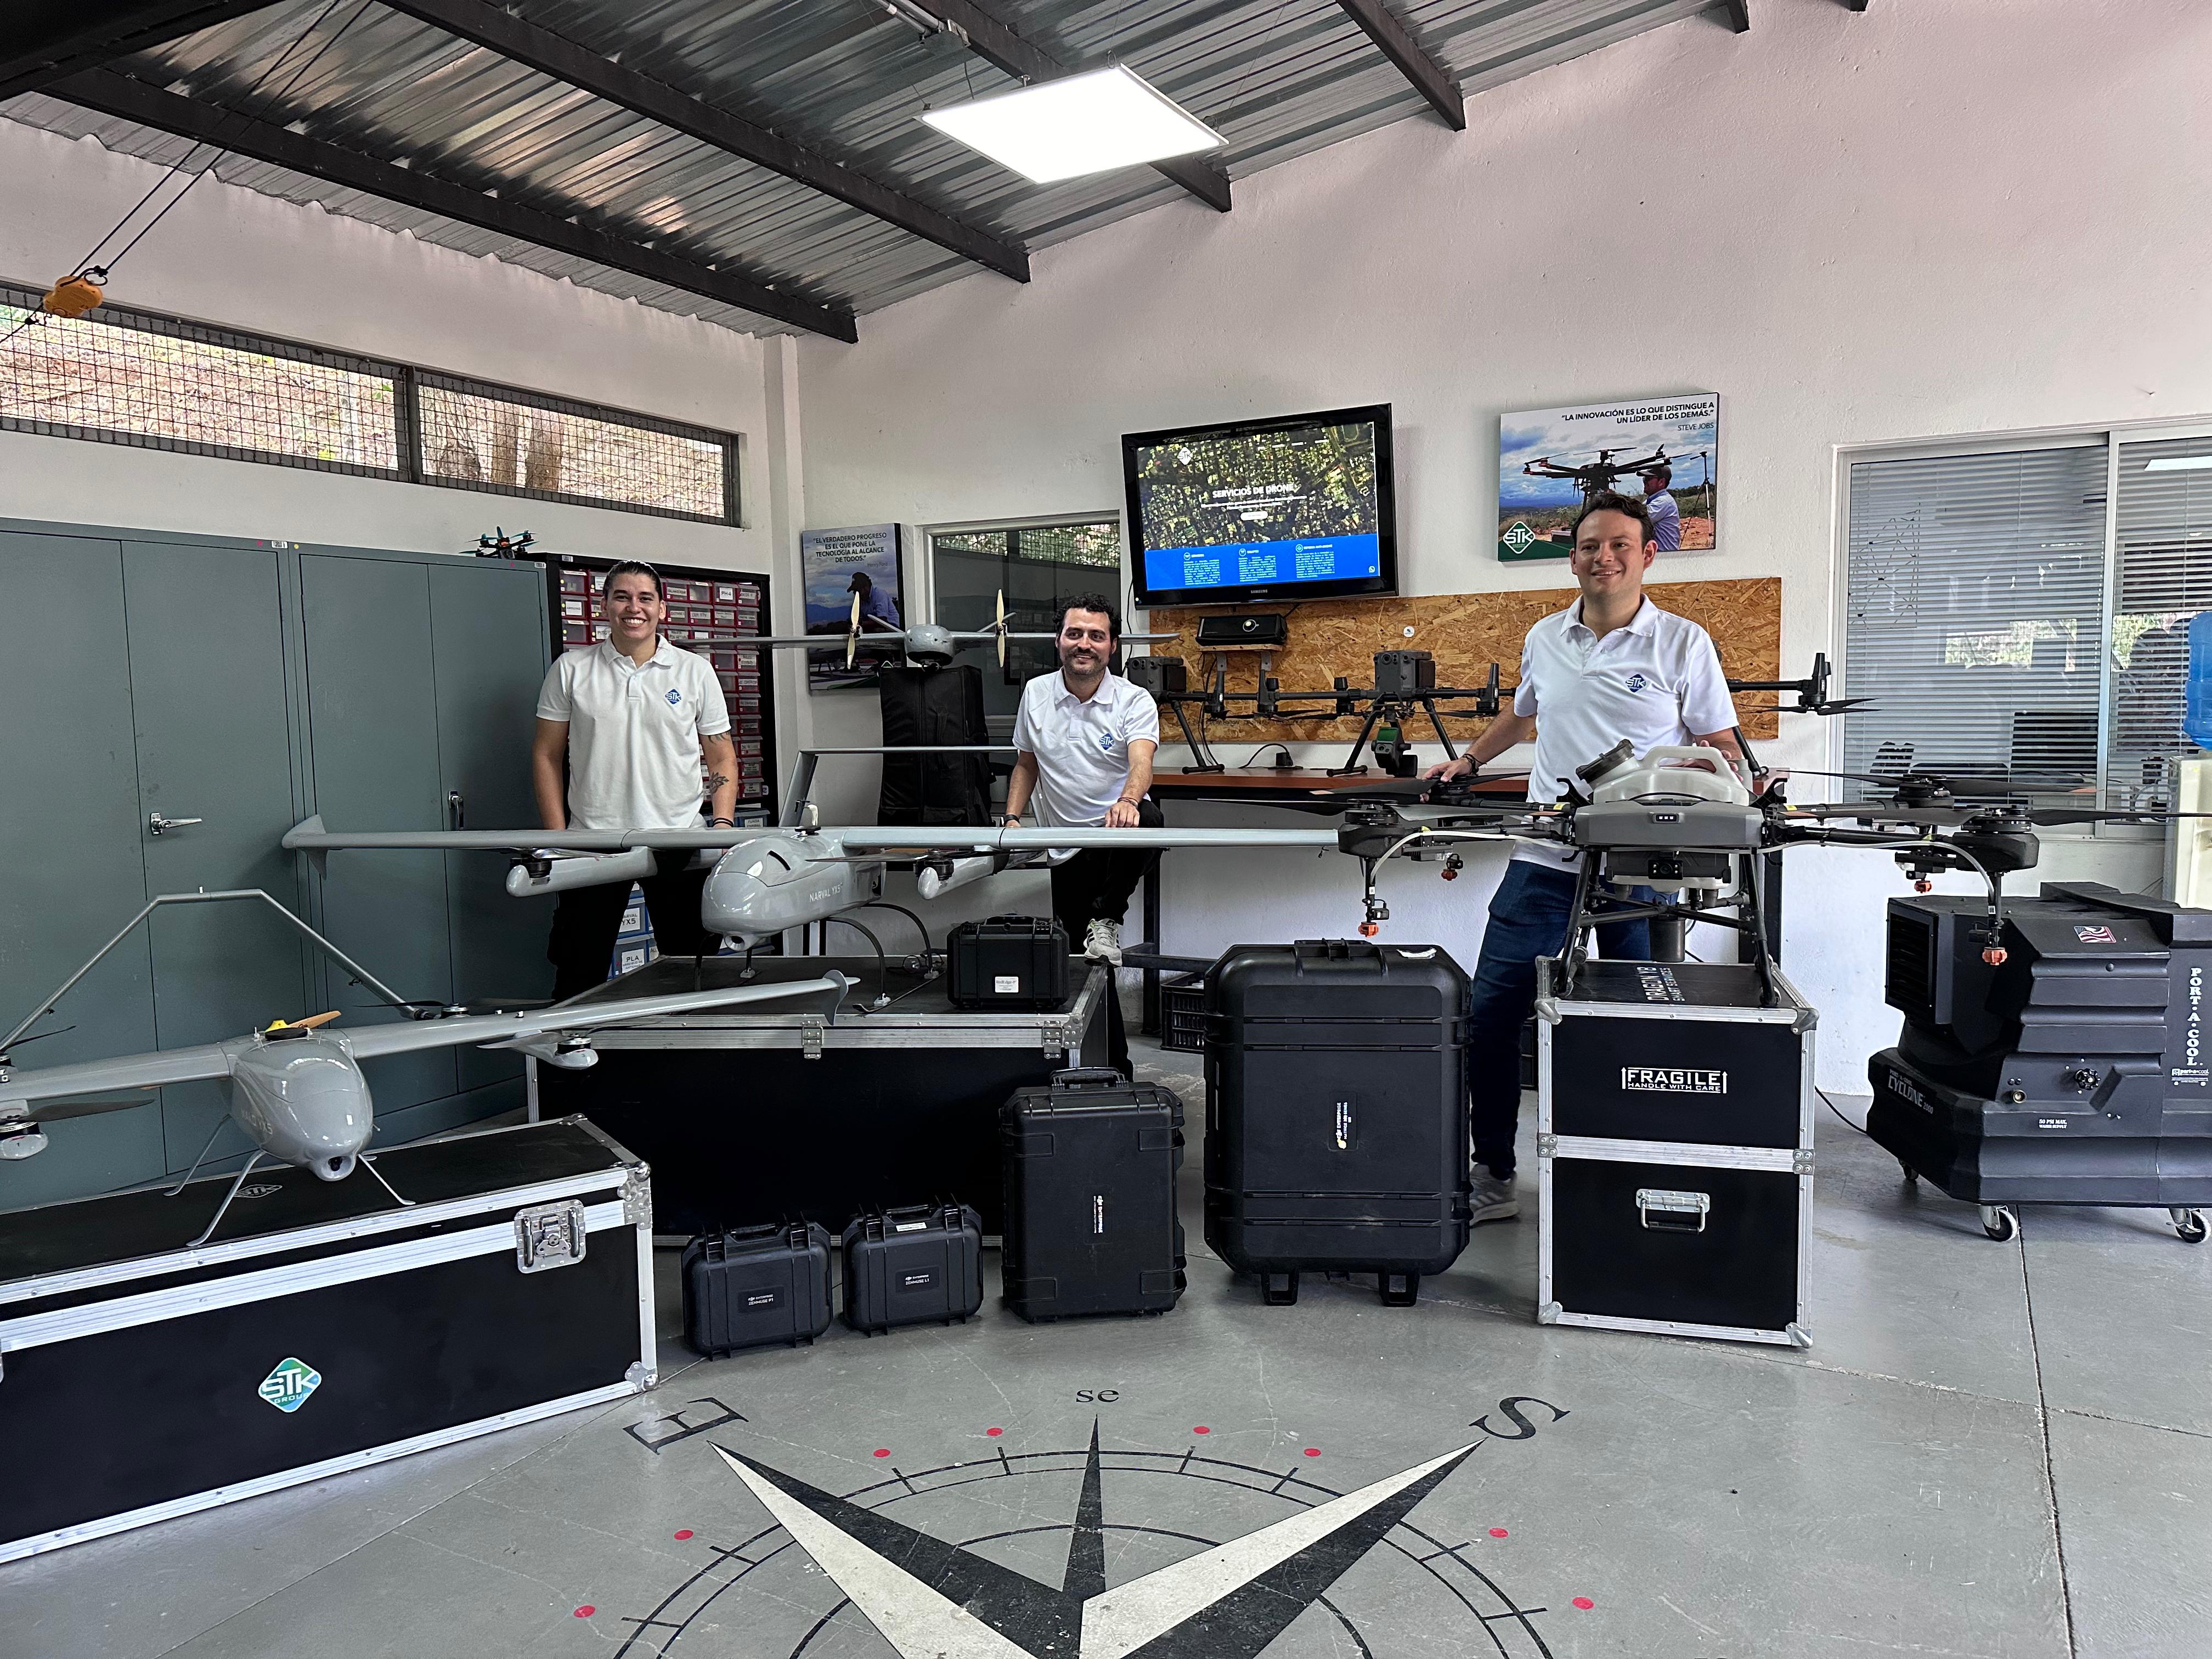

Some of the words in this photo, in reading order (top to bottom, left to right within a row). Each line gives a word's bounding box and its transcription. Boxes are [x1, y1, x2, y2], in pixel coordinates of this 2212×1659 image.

[1575, 408, 1624, 420] INNOVACIÓN
[1647, 406, 1664, 414] QUE
[1666, 403, 1707, 413] DISTINGUE
[1629, 414, 1651, 423] LÍDER
[1212, 487, 1252, 498] SERVICIOS
[1253, 486, 1264, 495] DE
[822, 534, 856, 543] VERDADERO
[856, 532, 887, 540] PROGRESO
[1505, 528, 1534, 544] STK
[1626, 678, 1646, 687] STK
[665, 692, 681, 701] STK
[1099, 736, 1114, 746] STK
[809, 888, 831, 902] NARVAL
[1659, 967, 1678, 986] SERVICES
[1640, 975, 1669, 1001] DRAGON
[1668, 986, 1685, 1001] SMART
[1627, 1069, 1720, 1086] FRAGILE
[1888, 1075, 1923, 1107] CYCLONE
[1923, 1102, 1933, 1114] 2000
[262, 1368, 317, 1399] STK
[274, 1392, 311, 1404] GROUP
[1076, 1390, 1119, 1402] se
[1468, 1396, 1571, 1440] S
[622, 1397, 750, 1455] E
